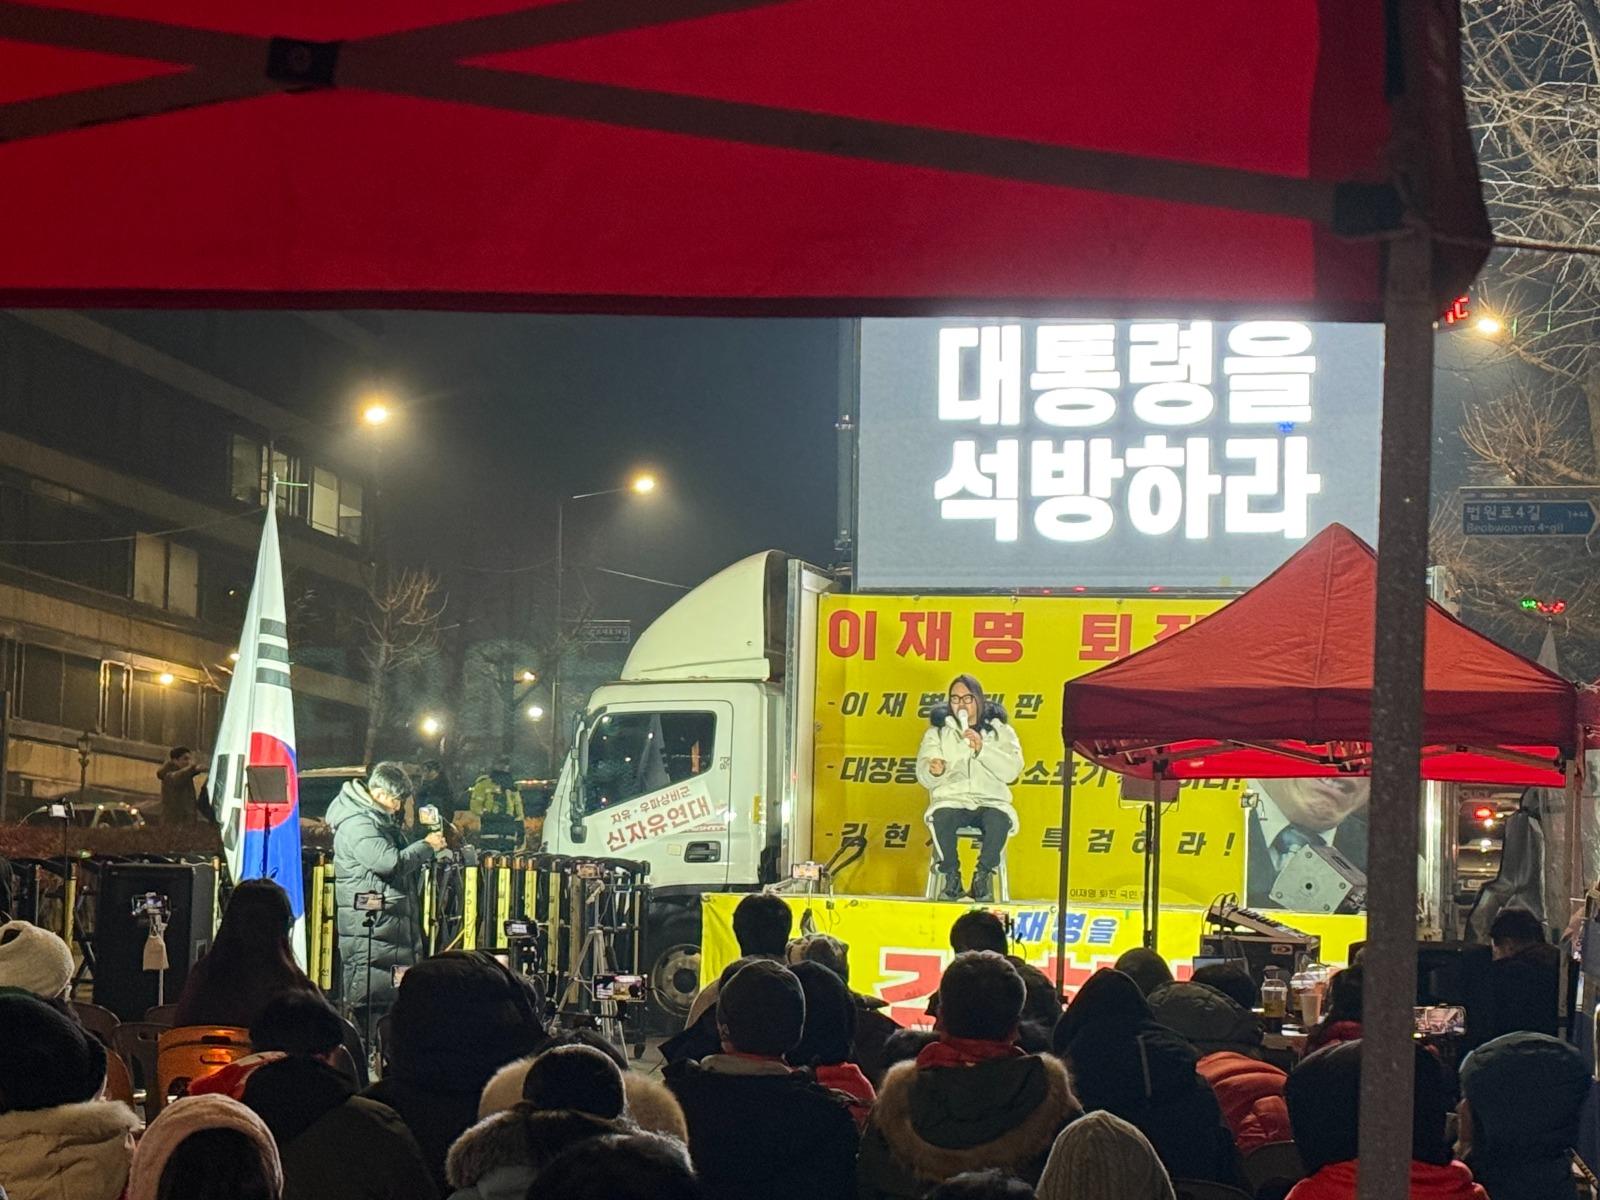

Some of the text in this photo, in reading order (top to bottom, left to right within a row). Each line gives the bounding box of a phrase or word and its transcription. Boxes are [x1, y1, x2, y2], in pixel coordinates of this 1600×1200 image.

[938, 320, 1317, 426] 대통령을
[934, 435, 1321, 542] 석방하라
[828, 609, 1025, 663] 이재명
[606, 795, 711, 852] 신자유연대
[610, 809, 632, 825] 자유
[1013, 911, 1117, 944] 재명을
